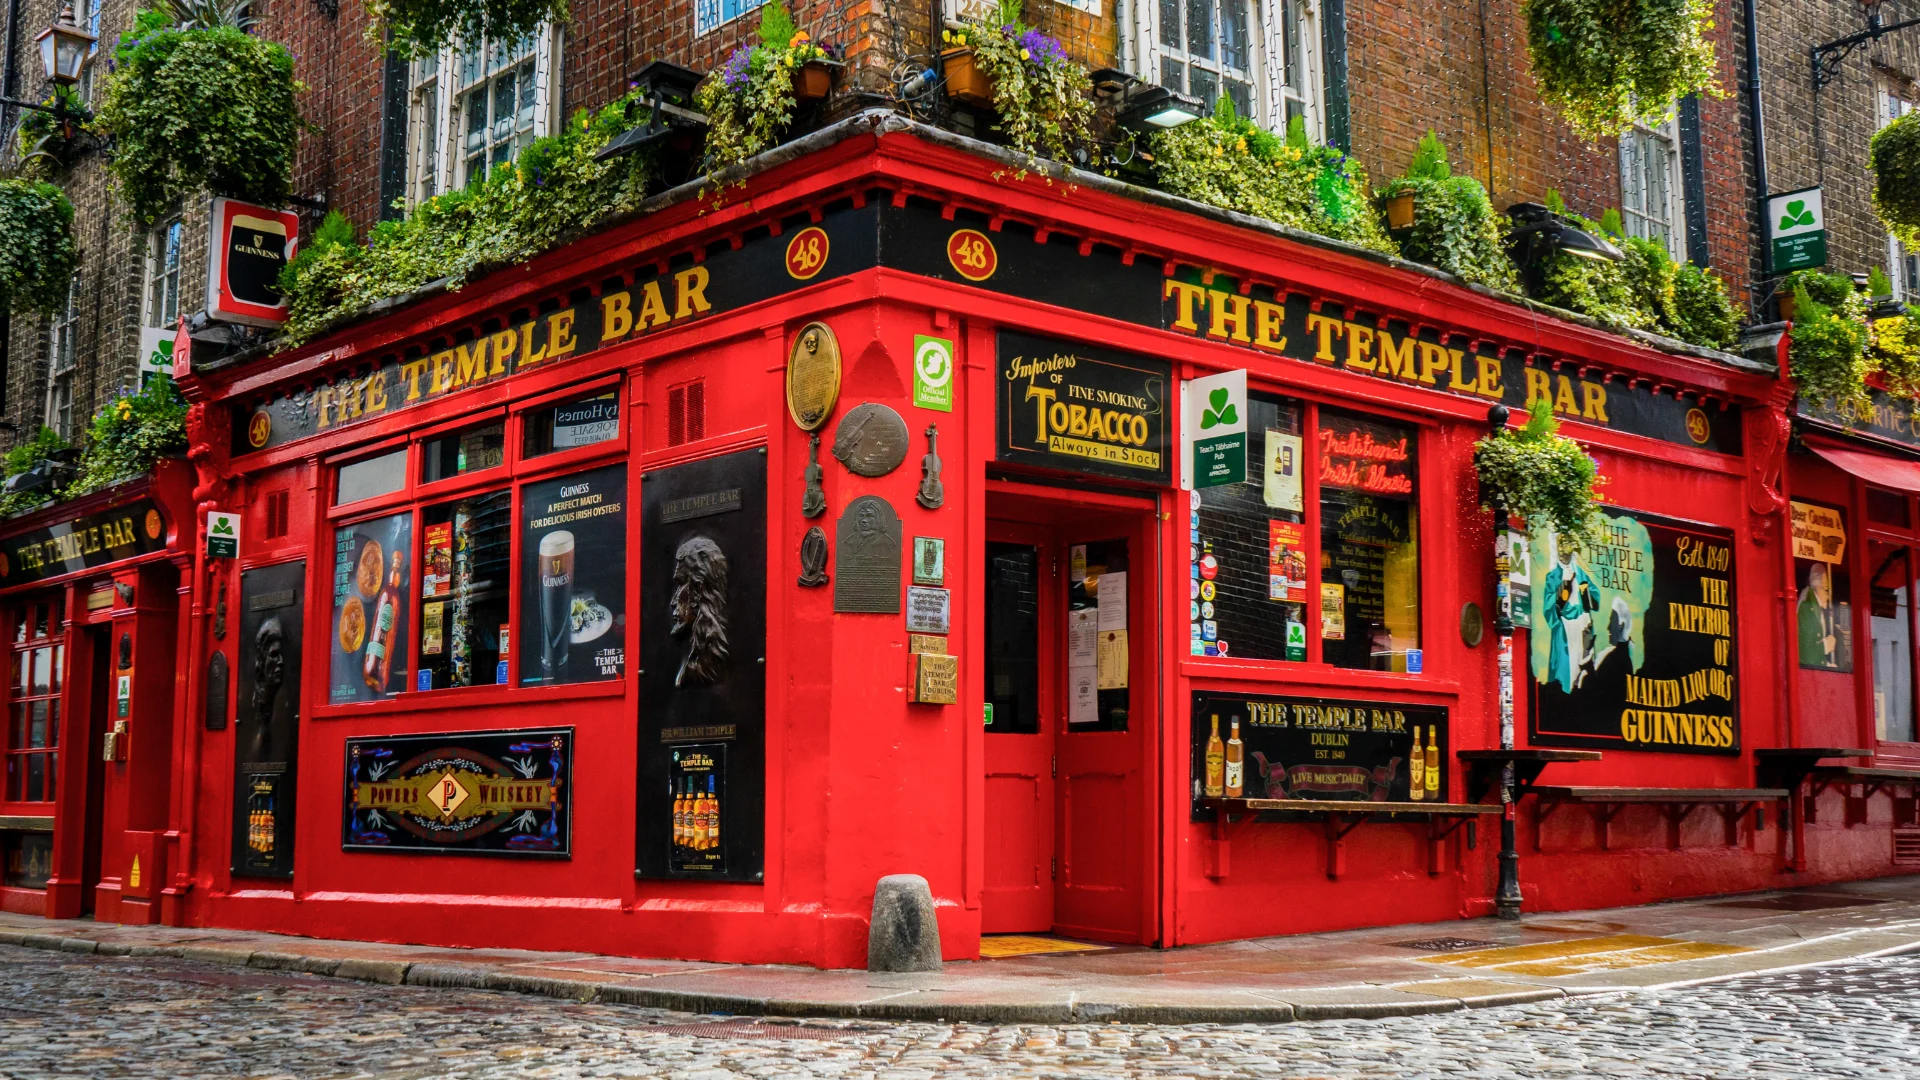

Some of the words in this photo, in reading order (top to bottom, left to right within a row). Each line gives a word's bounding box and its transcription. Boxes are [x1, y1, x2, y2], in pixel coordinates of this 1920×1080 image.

[234, 244, 280, 260] GUINNESS
[791, 236, 821, 271] 48
[955, 236, 987, 269] 48
[312, 371, 388, 430] THE
[402, 306, 577, 404] TEMPLE
[599, 265, 712, 342] BAR
[1165, 278, 1288, 354] THE
[1306, 312, 1505, 399] TEMPLE
[1524, 366, 1609, 422] BAR
[1005, 353, 1076, 384] Importers
[1050, 373, 1063, 384] OF
[921, 393, 946, 403] Member
[922, 386, 944, 396] Official
[1068, 384, 1094, 400] FINE
[1096, 390, 1148, 410] SMOKING
[1025, 384, 1149, 447] TOBACCO
[1690, 416, 1706, 436] 48
[252, 418, 266, 443] 48
[1052, 437, 1098, 456] Always
[1105, 446, 1116, 459] in
[1122, 447, 1158, 466] Stock
[1199, 445, 1214, 454] Teach
[1214, 452, 1224, 460] Pub
[1319, 429, 1408, 461] Traditional
[1319, 456, 1360, 485] Irish
[1364, 464, 1412, 494] Music
[560, 482, 590, 498] GUINNESS
[662, 502, 678, 514] THE
[682, 492, 718, 511] TEMPLE
[720, 490, 740, 502] BAR
[530, 520, 542, 529] FOR
[543, 512, 574, 526] DELICIOUS
[576, 508, 592, 520] IRISH
[593, 503, 620, 516] OYSTERS
[548, 504, 552, 513] A
[554, 498, 580, 512] PERFECT
[580, 494, 602, 506] MATCH
[1338, 505, 1378, 528] TEMPLE
[1382, 512, 1400, 538] BAR
[1808, 509, 1834, 528] Garden
[18, 543, 44, 570] THE
[45, 527, 100, 564] TEMPLE
[102, 516, 136, 549] BAR
[1600, 524, 1630, 548] THE
[1588, 542, 1644, 572] TEMPLE
[1706, 546, 1729, 572] 1840
[1798, 541, 1815, 557] Area
[542, 573, 570, 588] GUINNESS
[1600, 567, 1632, 594] BAR
[1701, 576, 1728, 606] THE
[1668, 602, 1730, 638] EMPEROR
[594, 654, 624, 666] TEMPLE
[603, 648, 616, 656] THE
[1714, 638, 1730, 666] OF
[601, 662, 617, 675] BAR
[1625, 674, 1680, 708] MALTED
[1680, 668, 1734, 704] LIQUORS
[1247, 702, 1288, 728] THE
[1292, 704, 1367, 732] TEMPLE
[1372, 710, 1407, 734] BAR
[1621, 708, 1733, 748] GUINNESS
[673, 726, 704, 738] WILLIAM
[705, 724, 734, 736] TEMPLE
[1311, 732, 1349, 746] DUBLIN
[680, 760, 702, 768] TEMPLE
[1315, 749, 1330, 760] EST.
[1331, 750, 1346, 760] 1840
[1292, 772, 1313, 784] LIVE
[1314, 773, 1340, 785] MUSIC
[1342, 773, 1366, 785] DAILY
[370, 786, 418, 804] POWERS
[442, 780, 456, 809] P
[479, 784, 543, 802] WHISKEY
